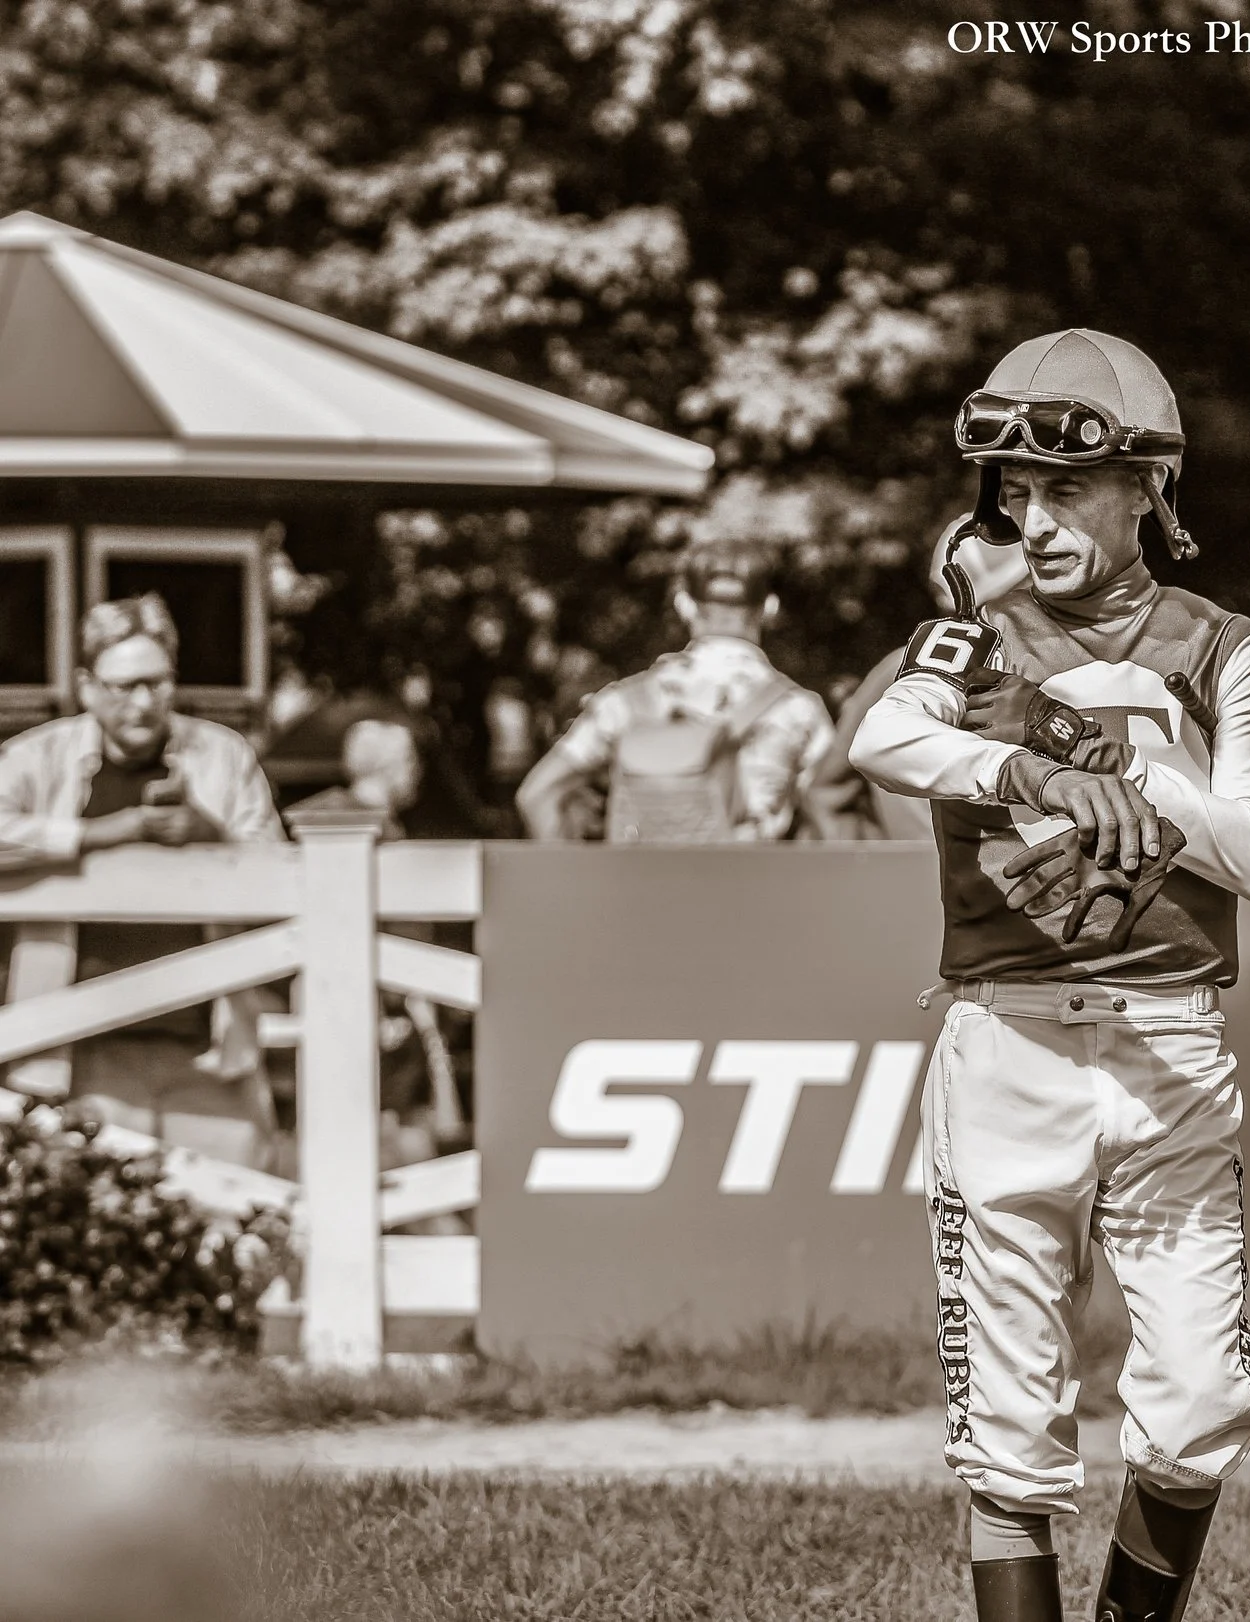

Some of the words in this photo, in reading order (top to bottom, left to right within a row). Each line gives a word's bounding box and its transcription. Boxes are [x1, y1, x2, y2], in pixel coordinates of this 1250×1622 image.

[915, 620, 984, 675] 6
[523, 1038, 926, 1195] STI
[934, 1182, 968, 1281] JEFF
[940, 1296, 973, 1445] RUBY'S
